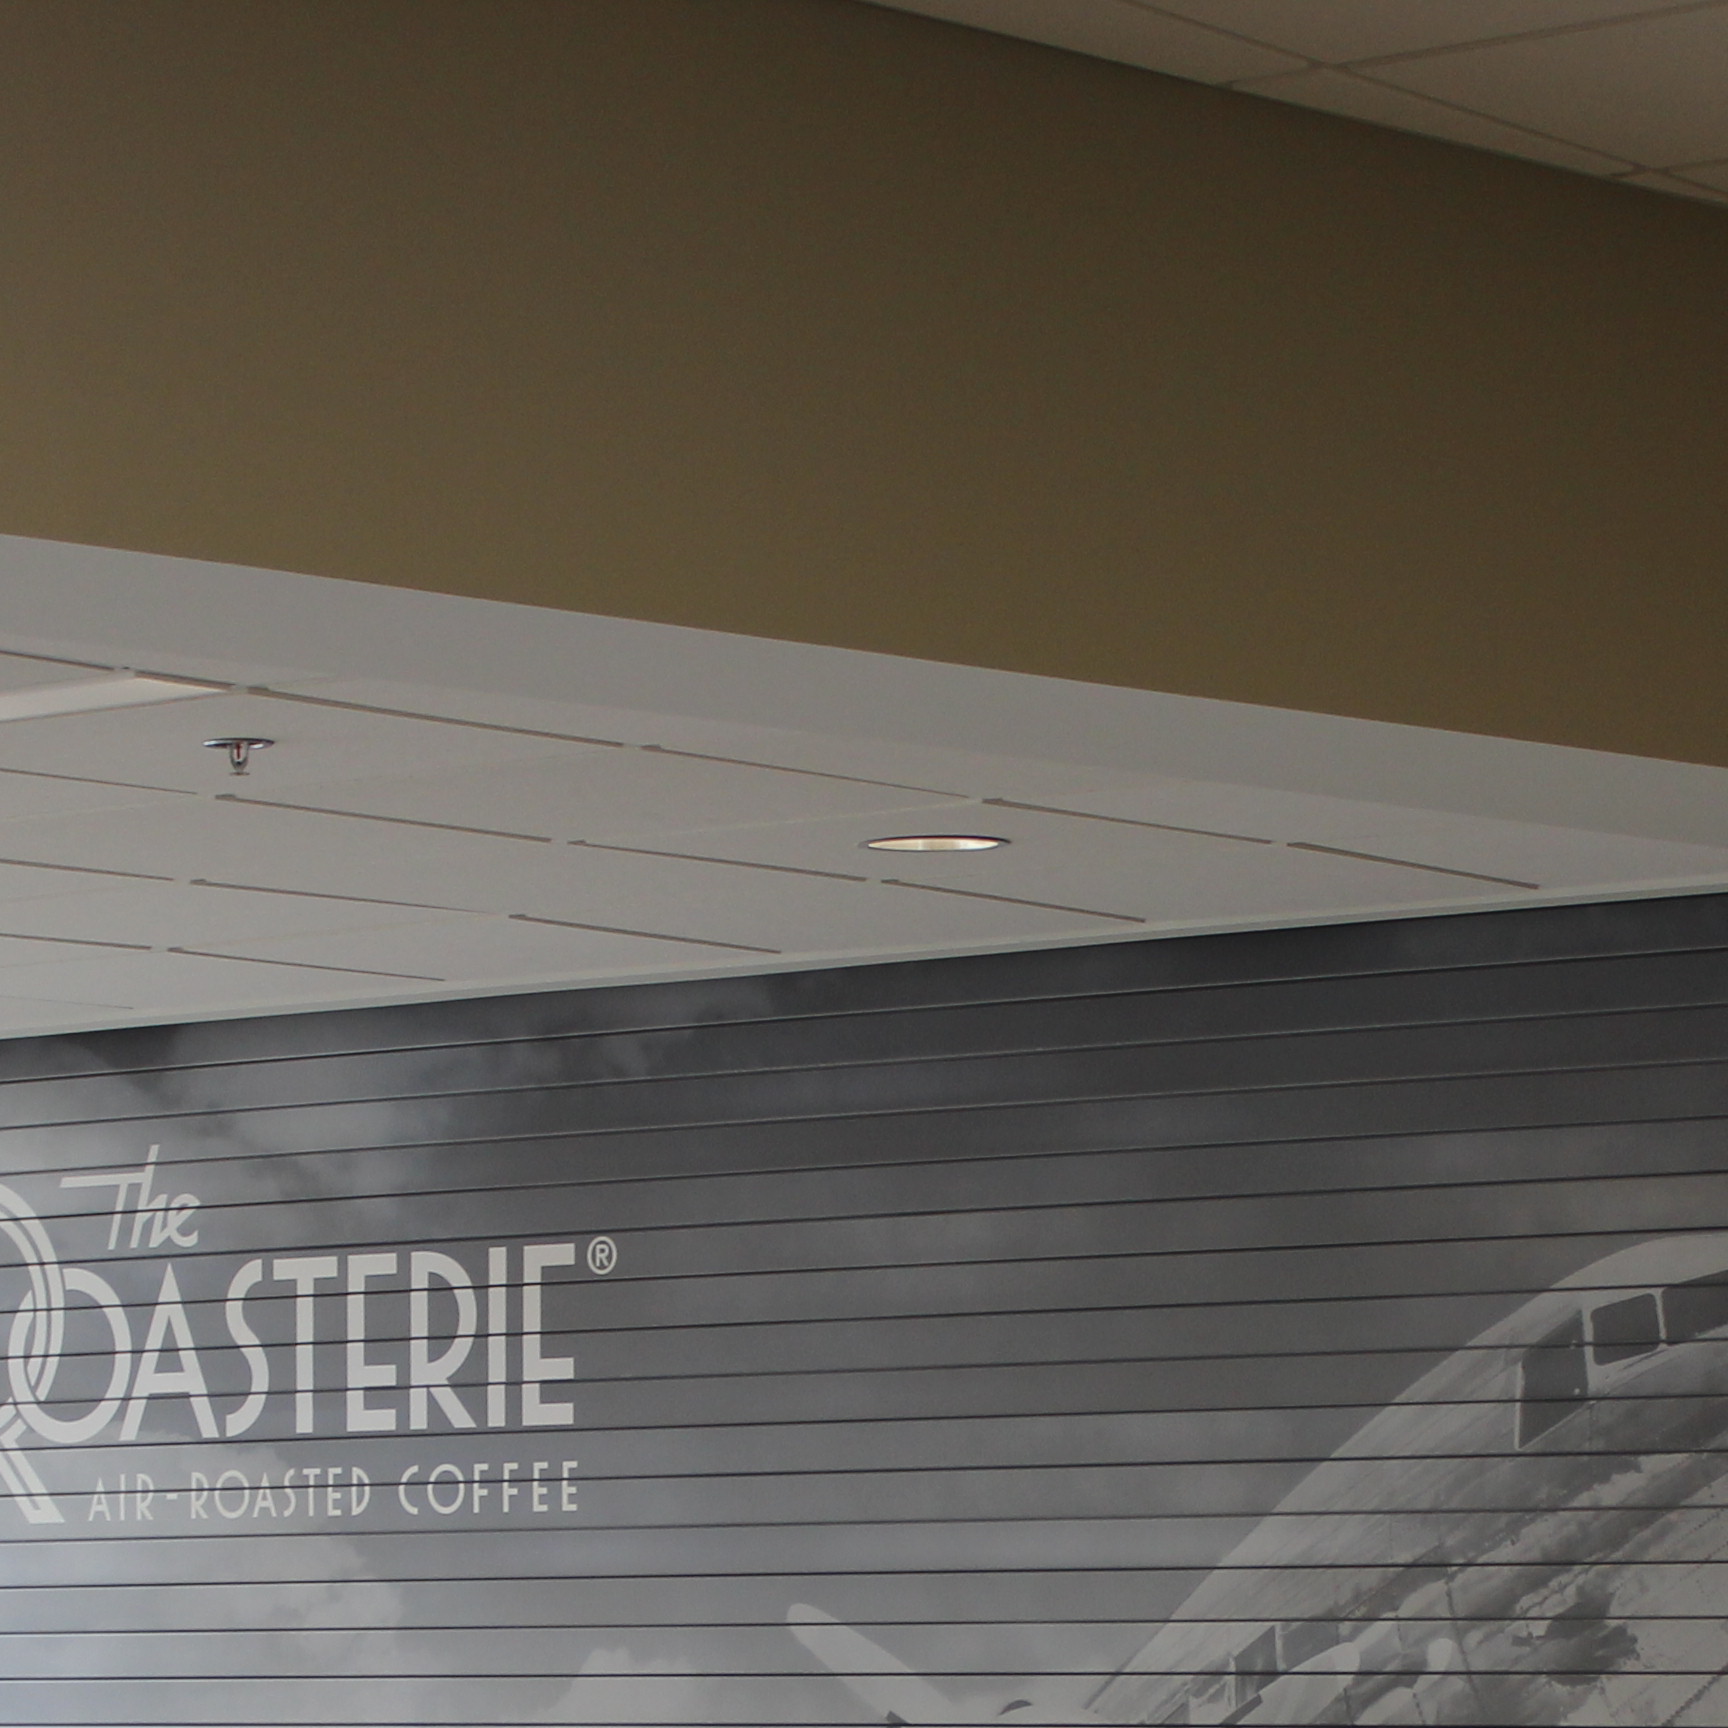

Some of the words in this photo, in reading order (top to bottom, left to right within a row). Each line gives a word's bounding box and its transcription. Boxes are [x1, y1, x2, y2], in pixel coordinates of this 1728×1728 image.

[60, 1144, 200, 1250] The
[88, 1465, 371, 1523] AIR-ROASTED
[398, 1460, 579, 1518] COFFEE
